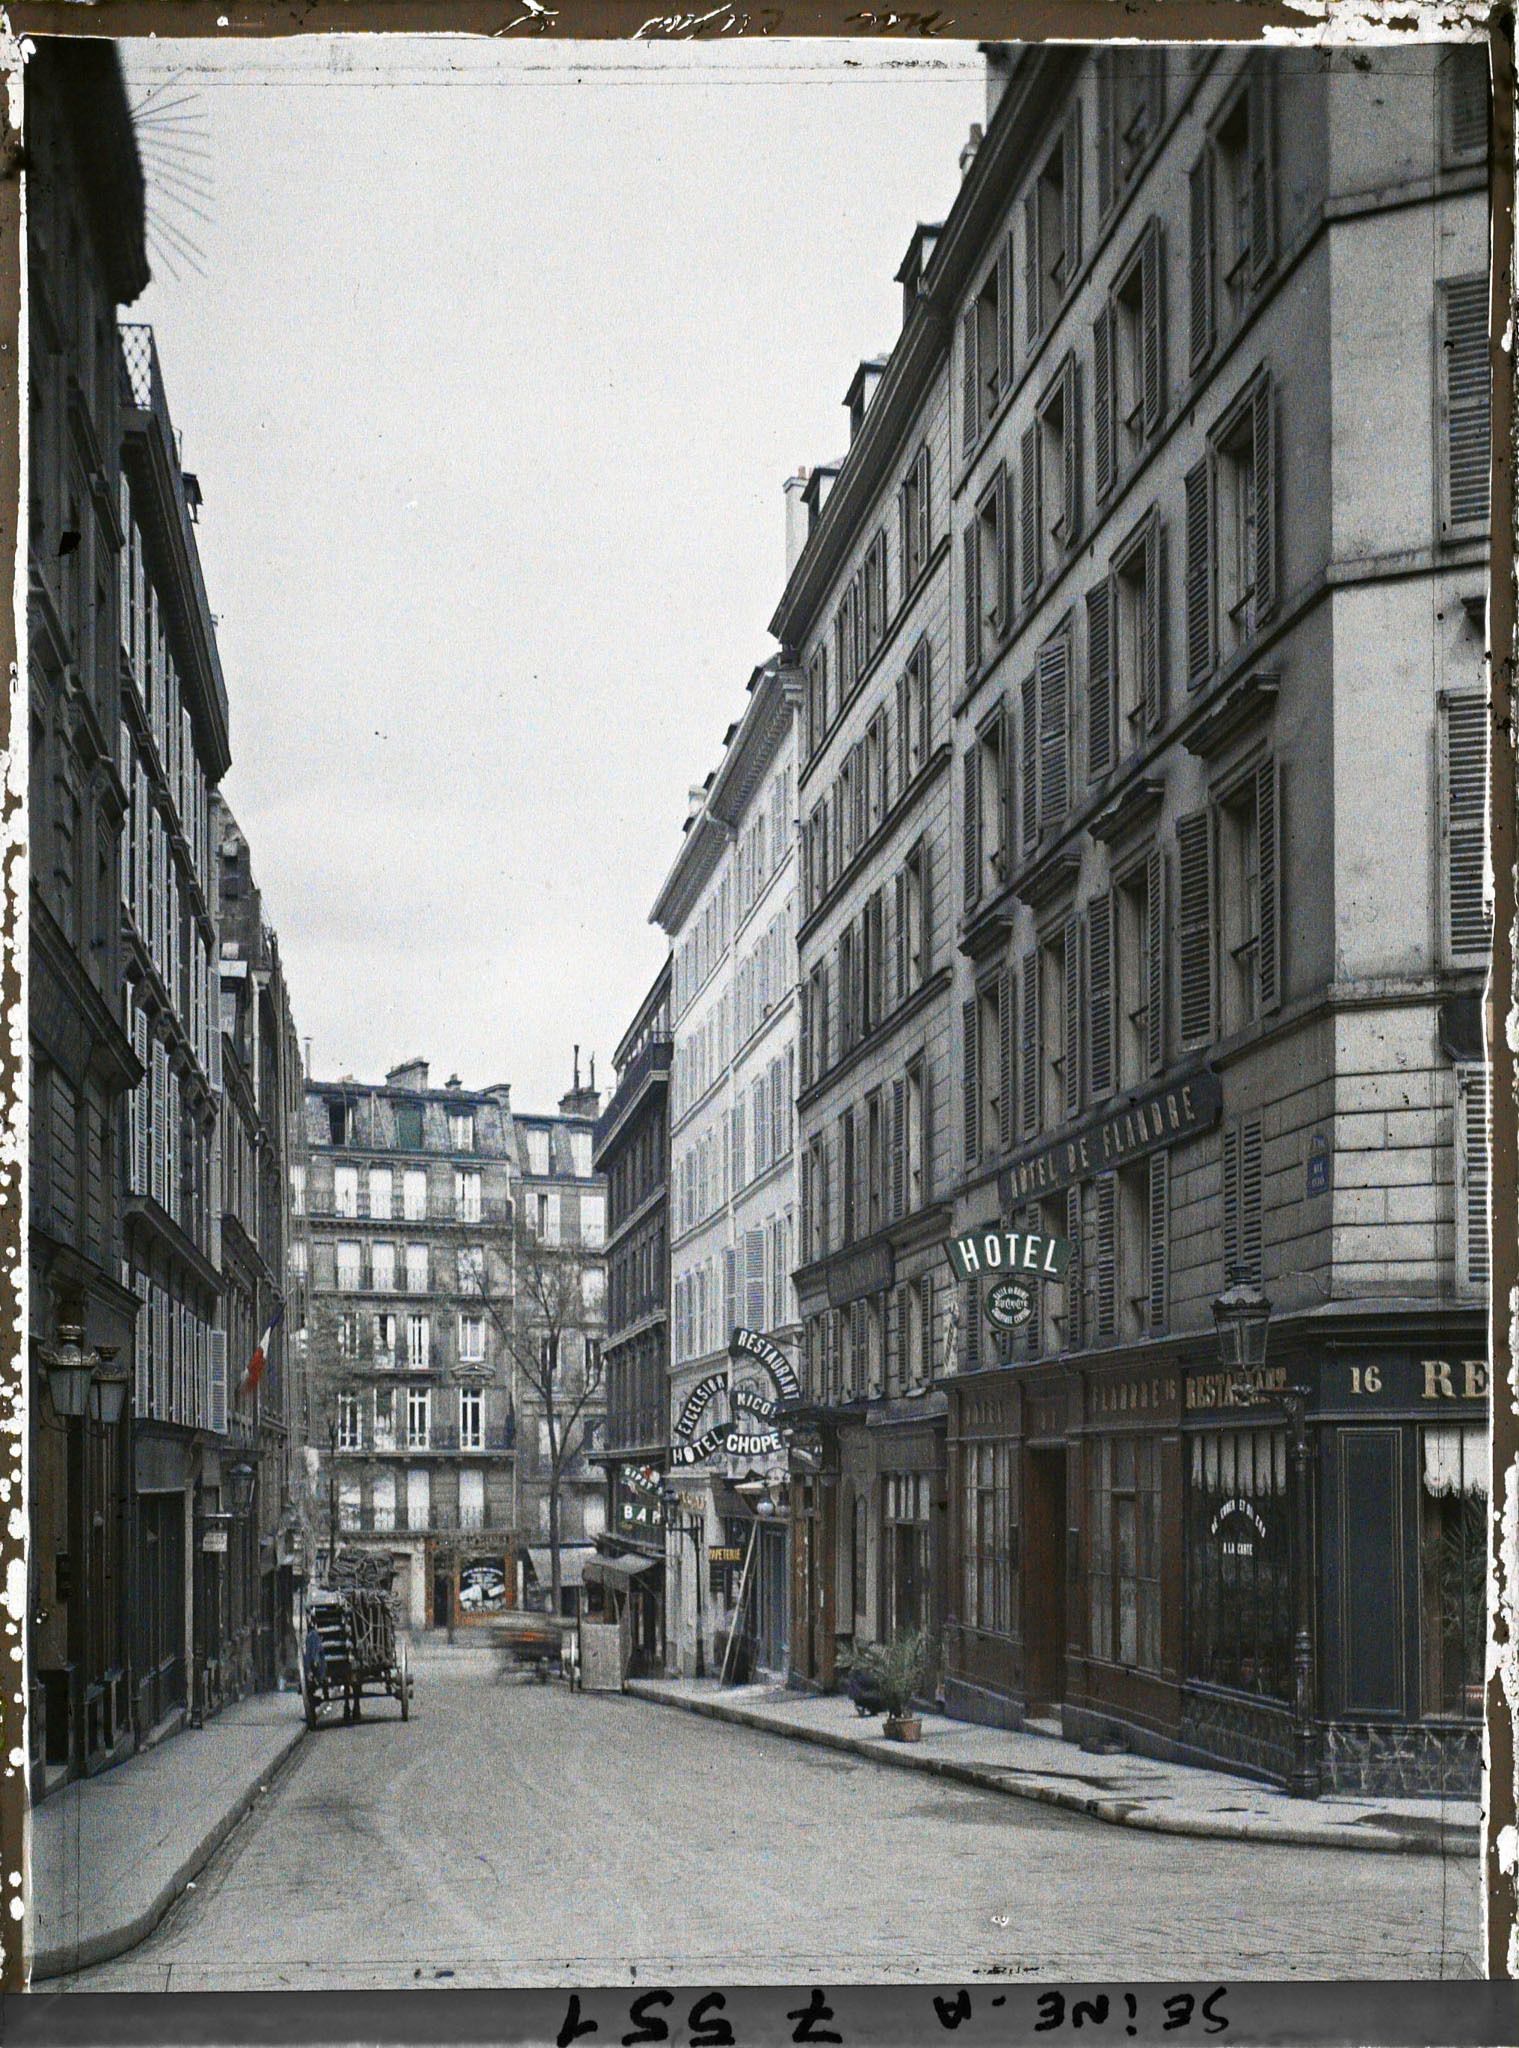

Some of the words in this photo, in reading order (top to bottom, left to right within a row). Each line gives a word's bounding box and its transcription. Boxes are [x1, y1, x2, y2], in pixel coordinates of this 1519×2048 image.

[1067, 1137, 1090, 1174] DE
[1102, 1085, 1196, 1158] FLANDRE
[958, 1234, 1058, 1273] HOTEL
[737, 1330, 800, 1400] RESTAURANT
[1351, 1365, 1383, 1394] 16
[1420, 1360, 1489, 1400] RE
[678, 1374, 726, 1436] EXCELSIOR
[673, 1431, 724, 1465] HOTEL
[726, 1432, 782, 1454] CHOPE
